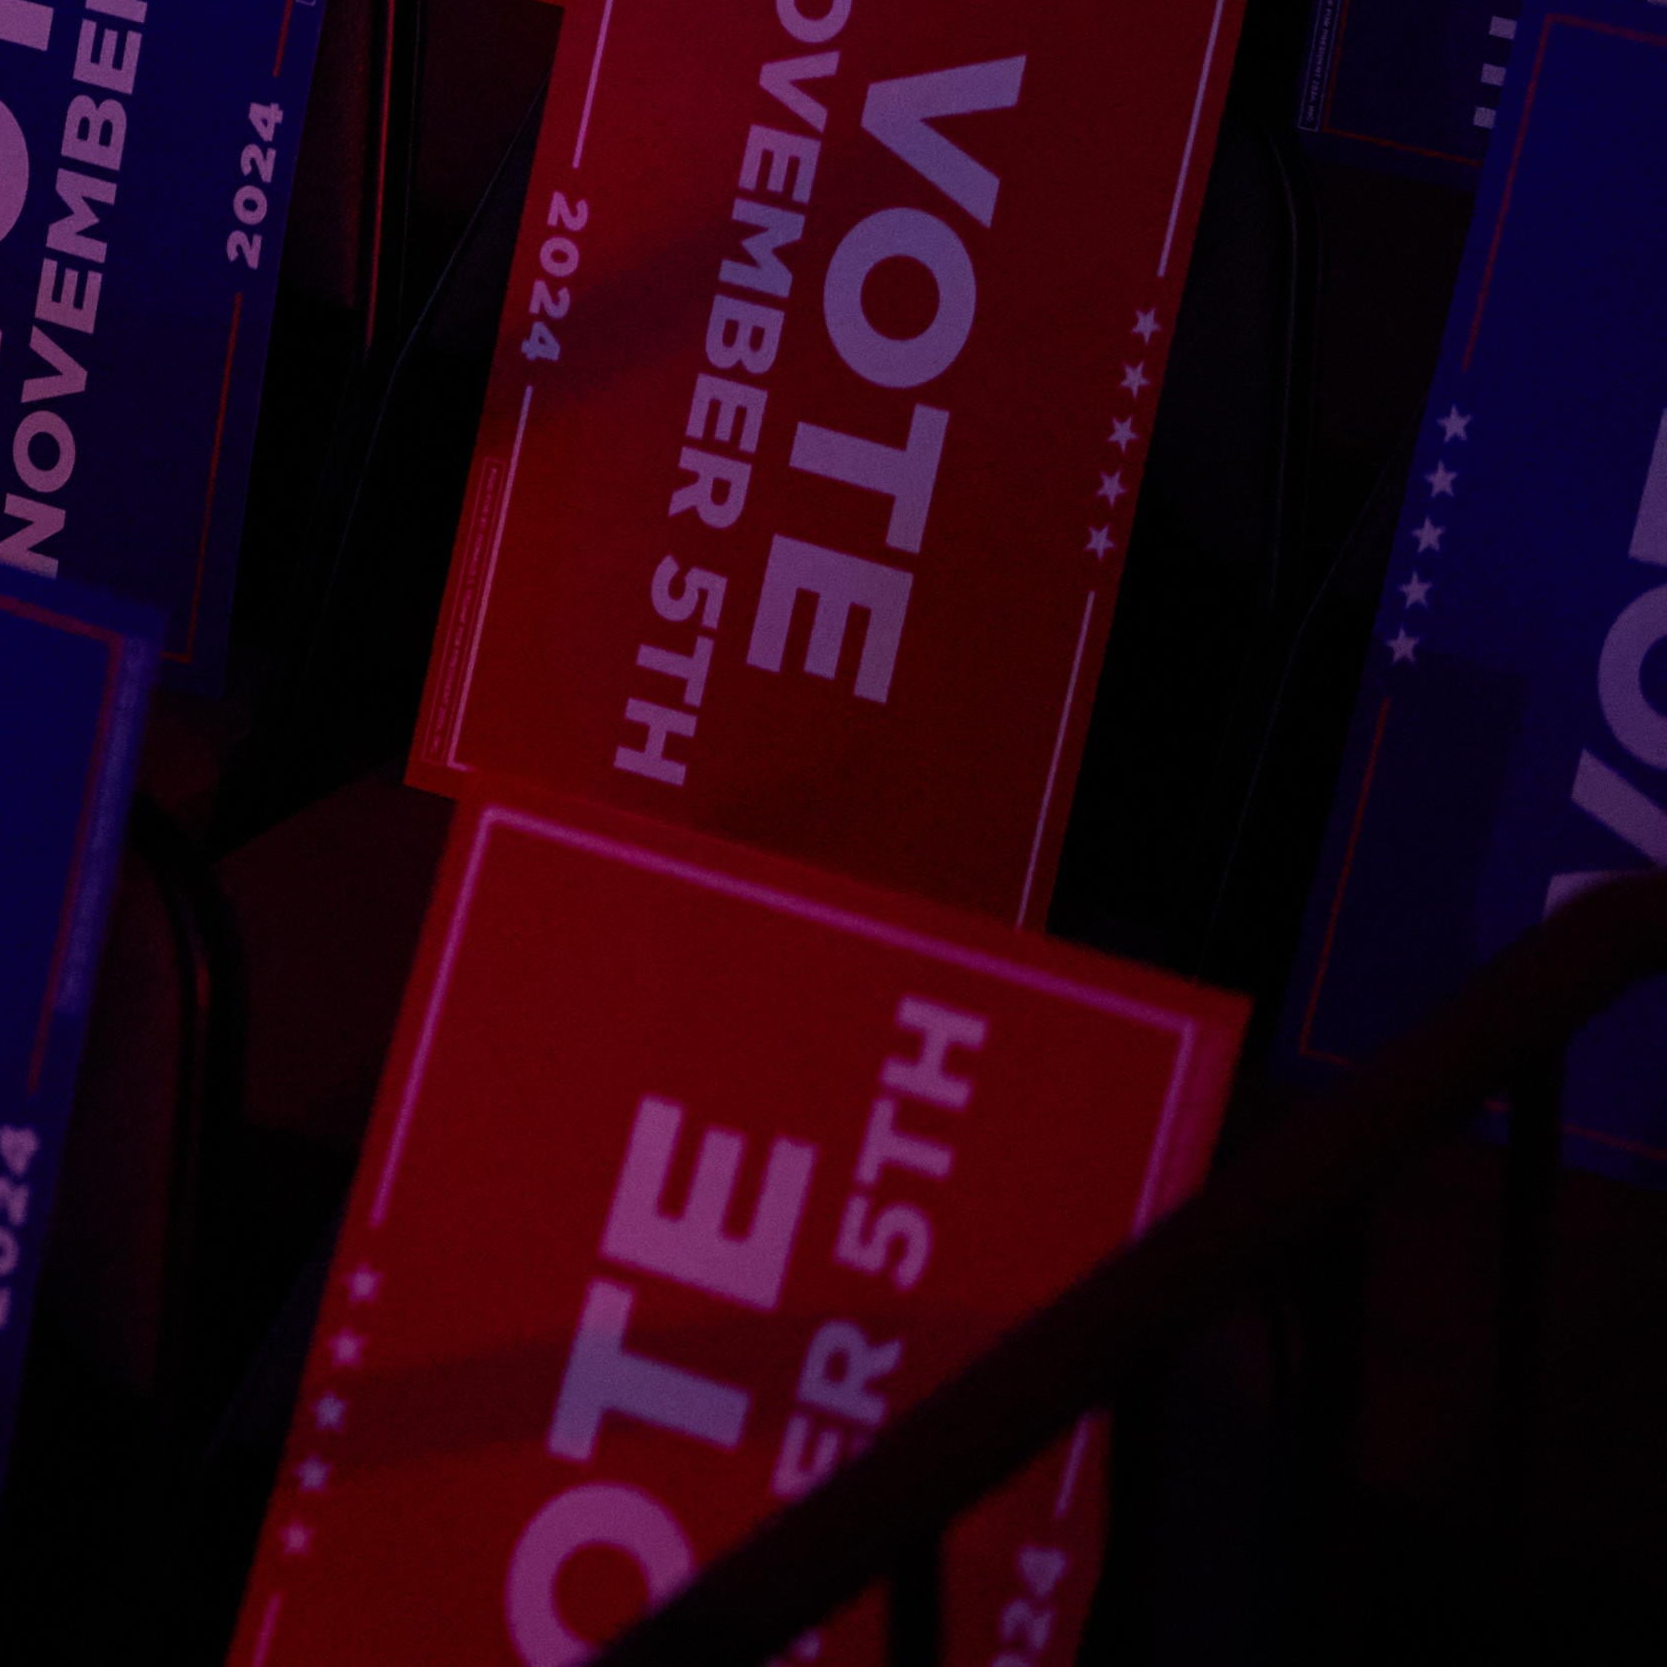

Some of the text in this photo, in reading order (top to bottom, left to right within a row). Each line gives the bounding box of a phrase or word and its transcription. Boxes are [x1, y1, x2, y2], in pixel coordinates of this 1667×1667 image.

[226, 102, 284, 269] 2024
[521, 191, 589, 361] 2024
[746, 55, 1027, 704] VOTE
[613, 555, 727, 786] 5TH
[838, 999, 985, 1285] 5TH
[510, 1099, 813, 1667] OTE
